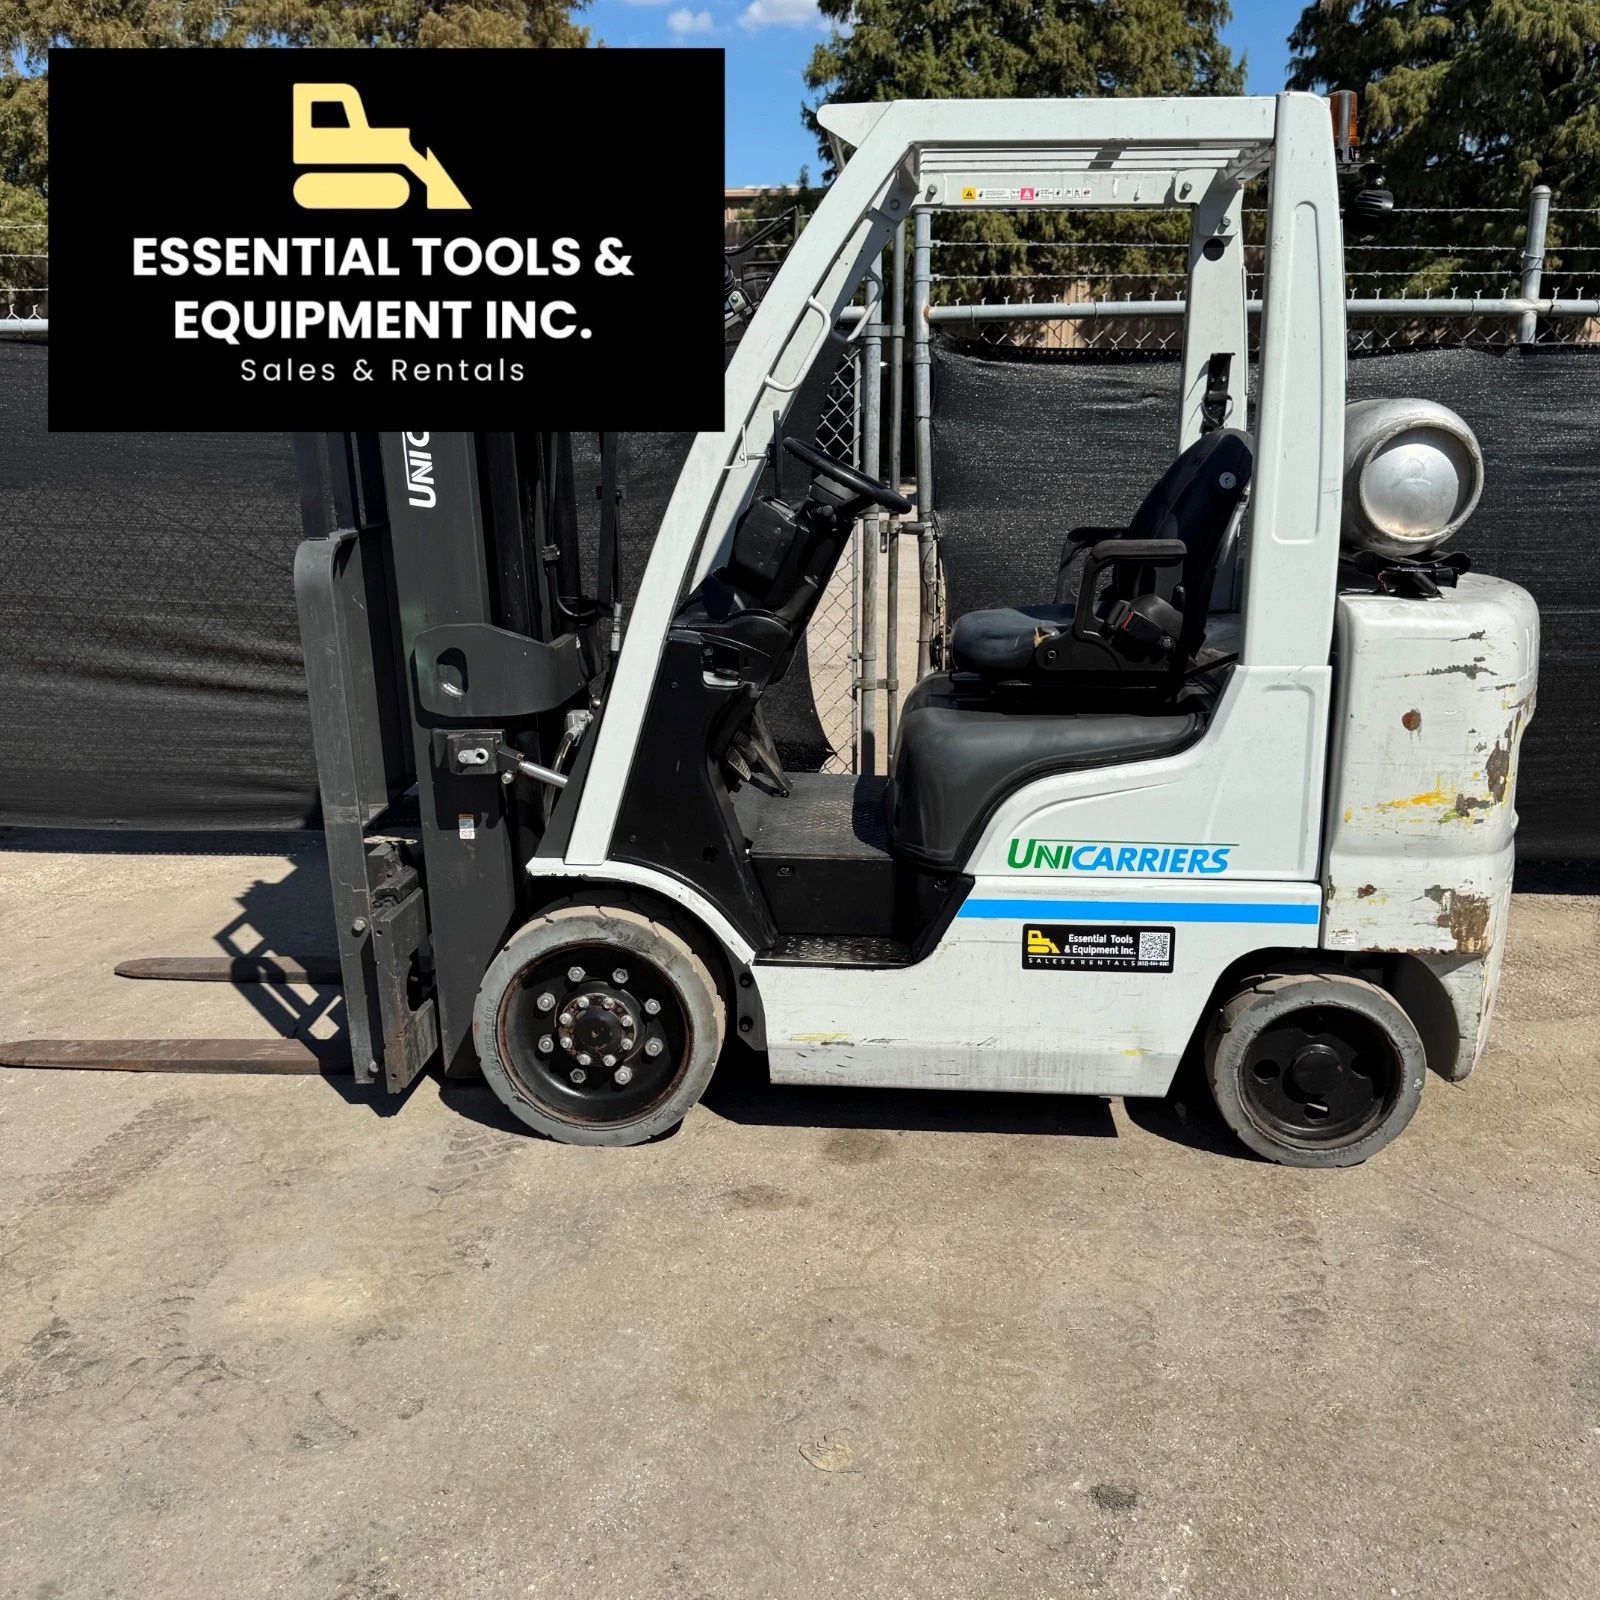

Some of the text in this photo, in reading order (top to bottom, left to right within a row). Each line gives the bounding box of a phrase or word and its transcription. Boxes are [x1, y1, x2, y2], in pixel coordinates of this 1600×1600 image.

[1007, 838, 1232, 874] UNICARRIERS
[1068, 934, 1134, 944] Essential Tools
[1064, 945, 1137, 956] & Equipment Inc.
